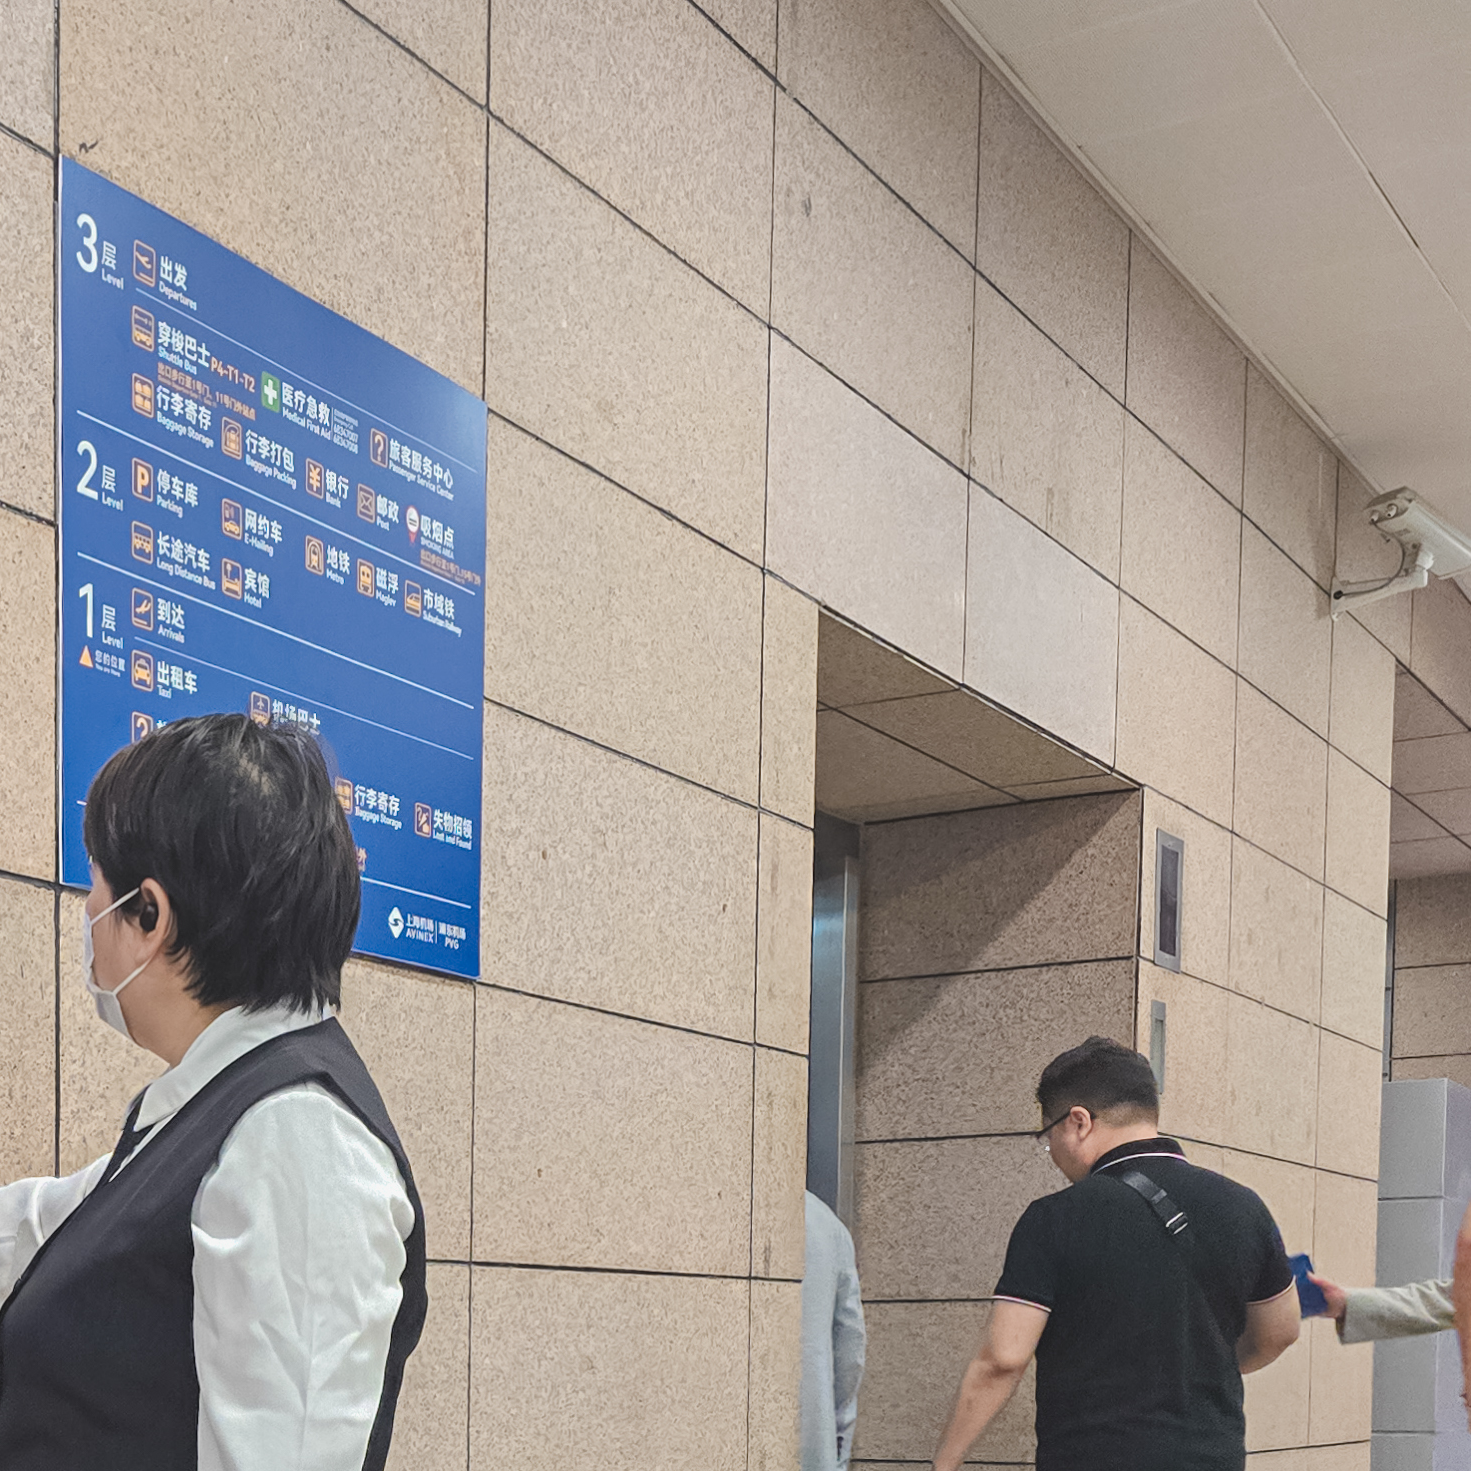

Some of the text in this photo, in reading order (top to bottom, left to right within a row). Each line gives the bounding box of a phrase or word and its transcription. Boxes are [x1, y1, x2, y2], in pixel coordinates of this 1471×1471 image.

[101, 268, 124, 290] Level
[160, 255, 187, 291] 出发
[159, 280, 197, 311] Departures
[157, 321, 210, 368] 穿梭巴士
[211, 356, 255, 393] P4-T1-T2
[158, 345, 197, 375] Shuttle Bus
[156, 385, 212, 431] 行李寄存
[282, 382, 330, 427] 医疗急救
[157, 410, 214, 449] Baggage Storage
[282, 407, 305, 428] Medical
[307, 419, 320, 436] First
[245, 429, 294, 473] 行李打包
[389, 438, 453, 489] 旅客服务中心
[246, 454, 297, 490] Baggage Packing
[326, 469, 349, 499] 银行
[389, 459, 416, 482] Passenger
[417, 474, 435, 493] Service
[102, 491, 124, 511] Level
[157, 468, 198, 507] 停车库
[326, 491, 341, 508] Bank
[157, 494, 183, 519] Parking
[376, 494, 399, 524] 邮政
[244, 508, 282, 543] 网约车
[376, 515, 389, 531] Post
[420, 514, 454, 550] 吸烟点
[157, 531, 210, 573] 长途汽车
[326, 545, 350, 575] 地铁
[157, 557, 216, 590] Long Distance Bus
[244, 568, 270, 599] 宾馆
[326, 568, 345, 585] Metro
[376, 566, 399, 594] 磁浮
[244, 592, 262, 609] Hotel
[376, 589, 396, 607] Maglev
[423, 588, 455, 620] 市域铁
[157, 597, 185, 630] 到达
[102, 630, 124, 650] Level
[158, 624, 185, 643] Arrivals
[95, 650, 126, 672] 您的位置
[157, 661, 198, 694] 出租车
[157, 685, 172, 699] Taxi
[272, 698, 321, 735] 机场巴士
[354, 784, 400, 816] 行李寄存
[354, 806, 402, 830] Baggage Storage
[433, 809, 473, 839] 失物招领
[455, 837, 472, 851] Found
[444, 936, 460, 950] PVG
